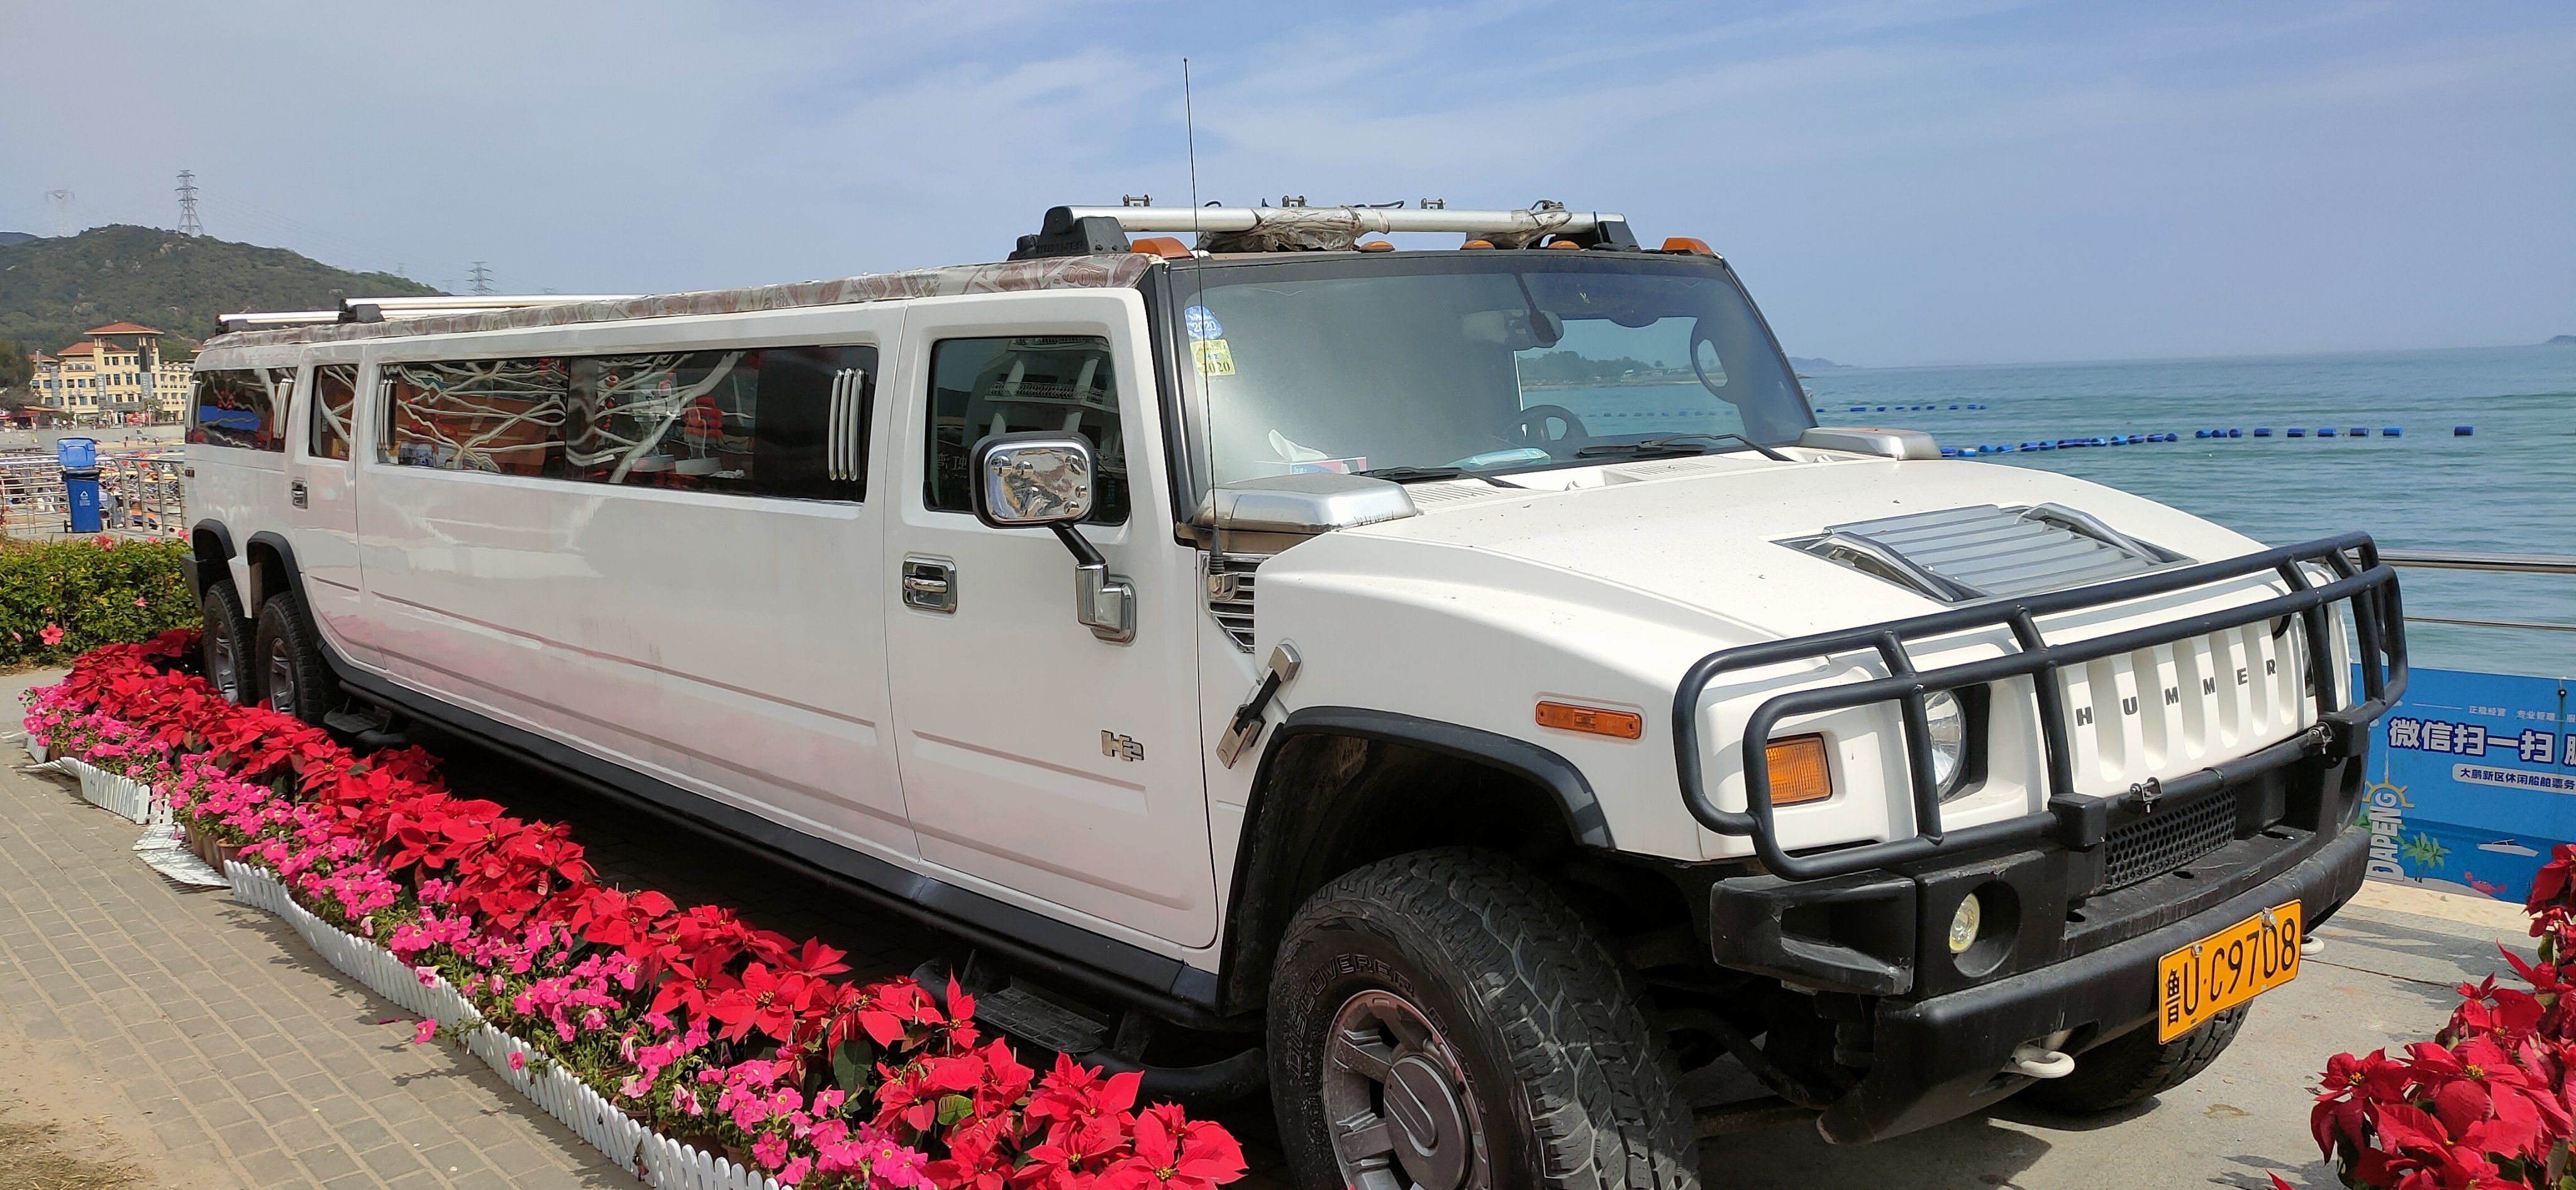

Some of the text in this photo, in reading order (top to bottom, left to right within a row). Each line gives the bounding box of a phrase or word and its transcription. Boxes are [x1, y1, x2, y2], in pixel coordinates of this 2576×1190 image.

[2075, 659, 2277, 726] HUMMER
[2389, 718, 2553, 763] 微信扫一扫
[2365, 792, 2405, 881] DAPENG
[1287, 952, 1415, 1073] DISCOVERER
